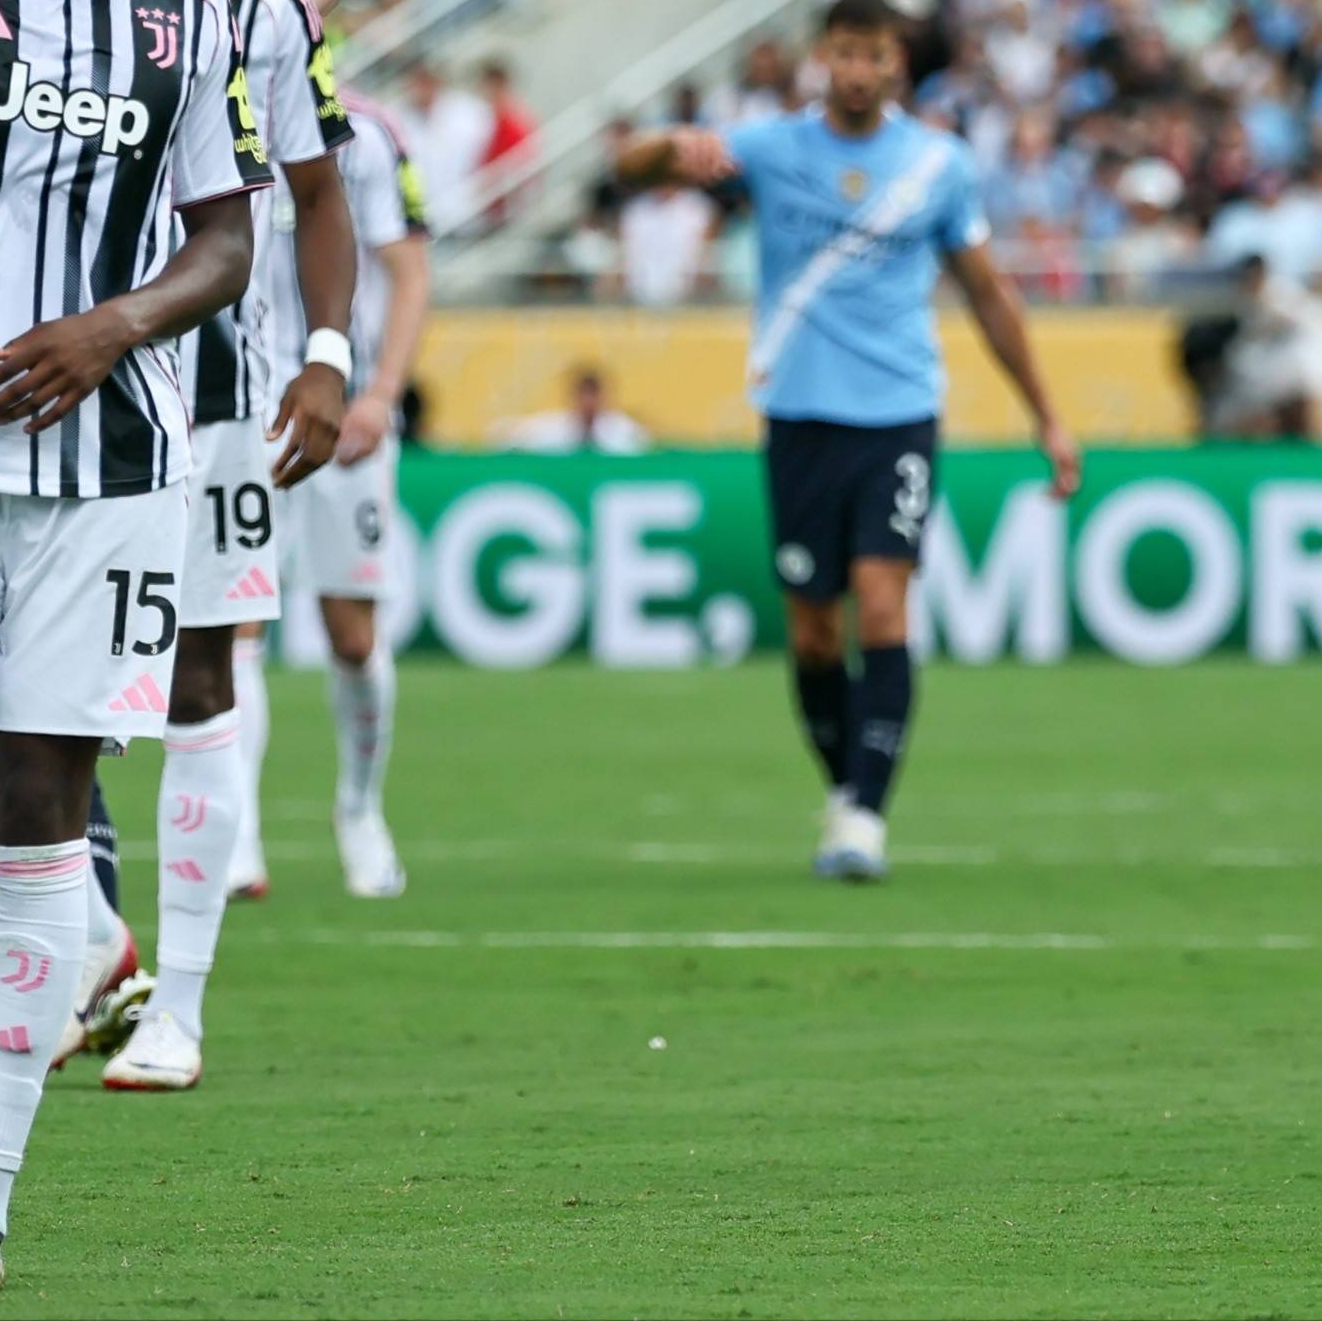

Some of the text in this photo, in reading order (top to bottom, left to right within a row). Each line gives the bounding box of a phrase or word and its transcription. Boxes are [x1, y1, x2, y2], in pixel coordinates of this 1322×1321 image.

[205, 482, 272, 554] 19
[894, 452, 930, 520] 3
[106, 569, 177, 656] 15
